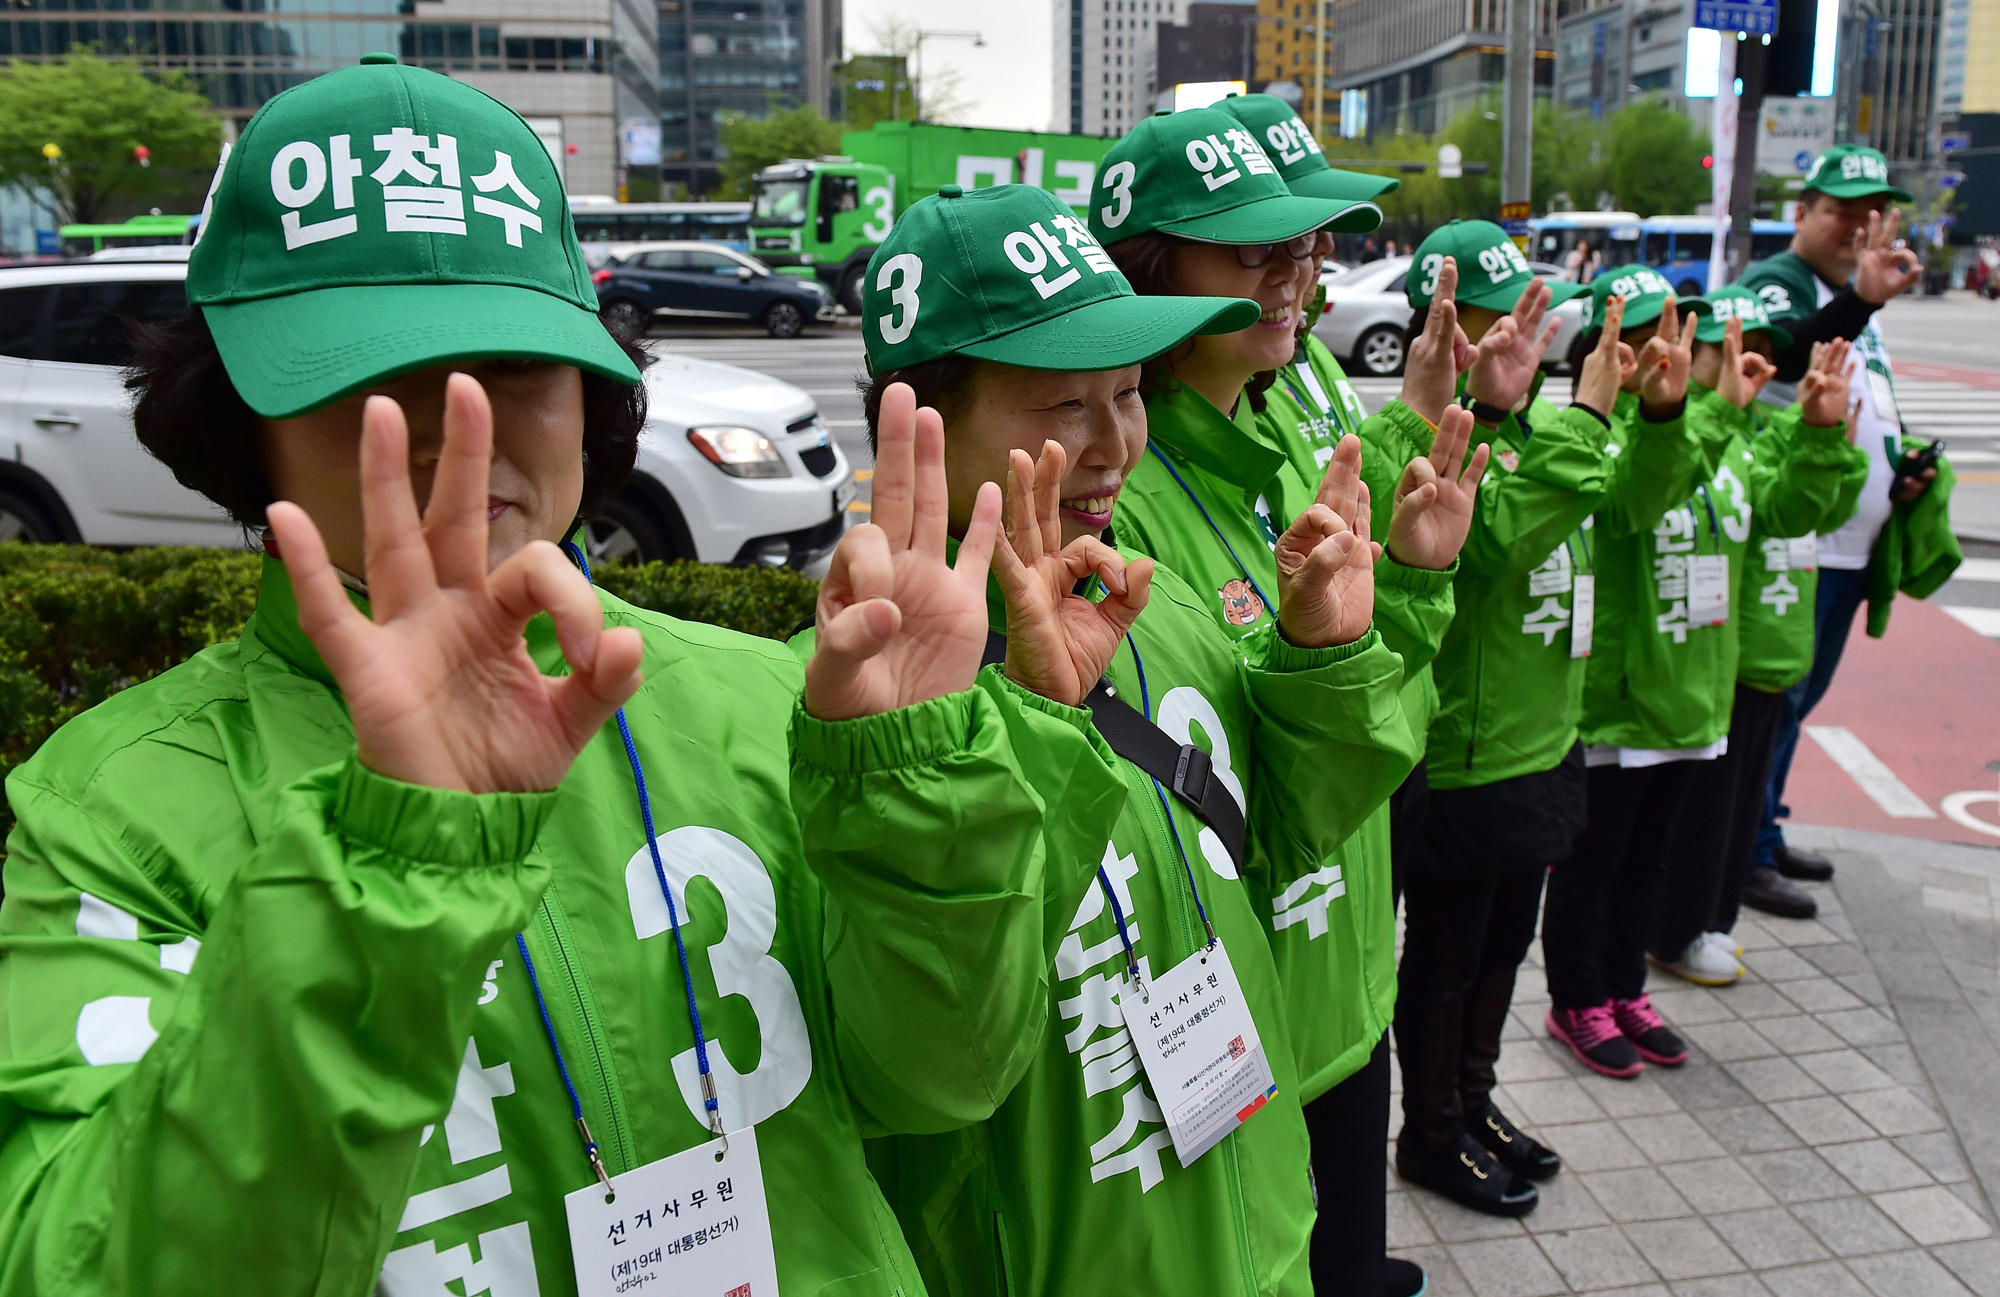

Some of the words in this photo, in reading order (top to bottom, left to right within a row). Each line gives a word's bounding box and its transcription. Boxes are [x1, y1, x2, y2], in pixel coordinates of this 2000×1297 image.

[270, 127, 543, 251] 안철수
[862, 186, 894, 243] 3
[1100, 161, 1136, 228] 3
[876, 253, 923, 345] 3
[1421, 253, 1445, 296] 3
[1758, 284, 1792, 313] 3
[1712, 465, 1752, 542] 3
[625, 825, 812, 1135] 3
[1156, 1023, 1186, 1050] (제19대
[1186, 995, 1227, 1030] 대통령선거)
[607, 1177, 734, 1246] 선거사무원
[611, 1247, 662, 1281] (제19대
[667, 1215, 739, 1256] 대통령선거)
